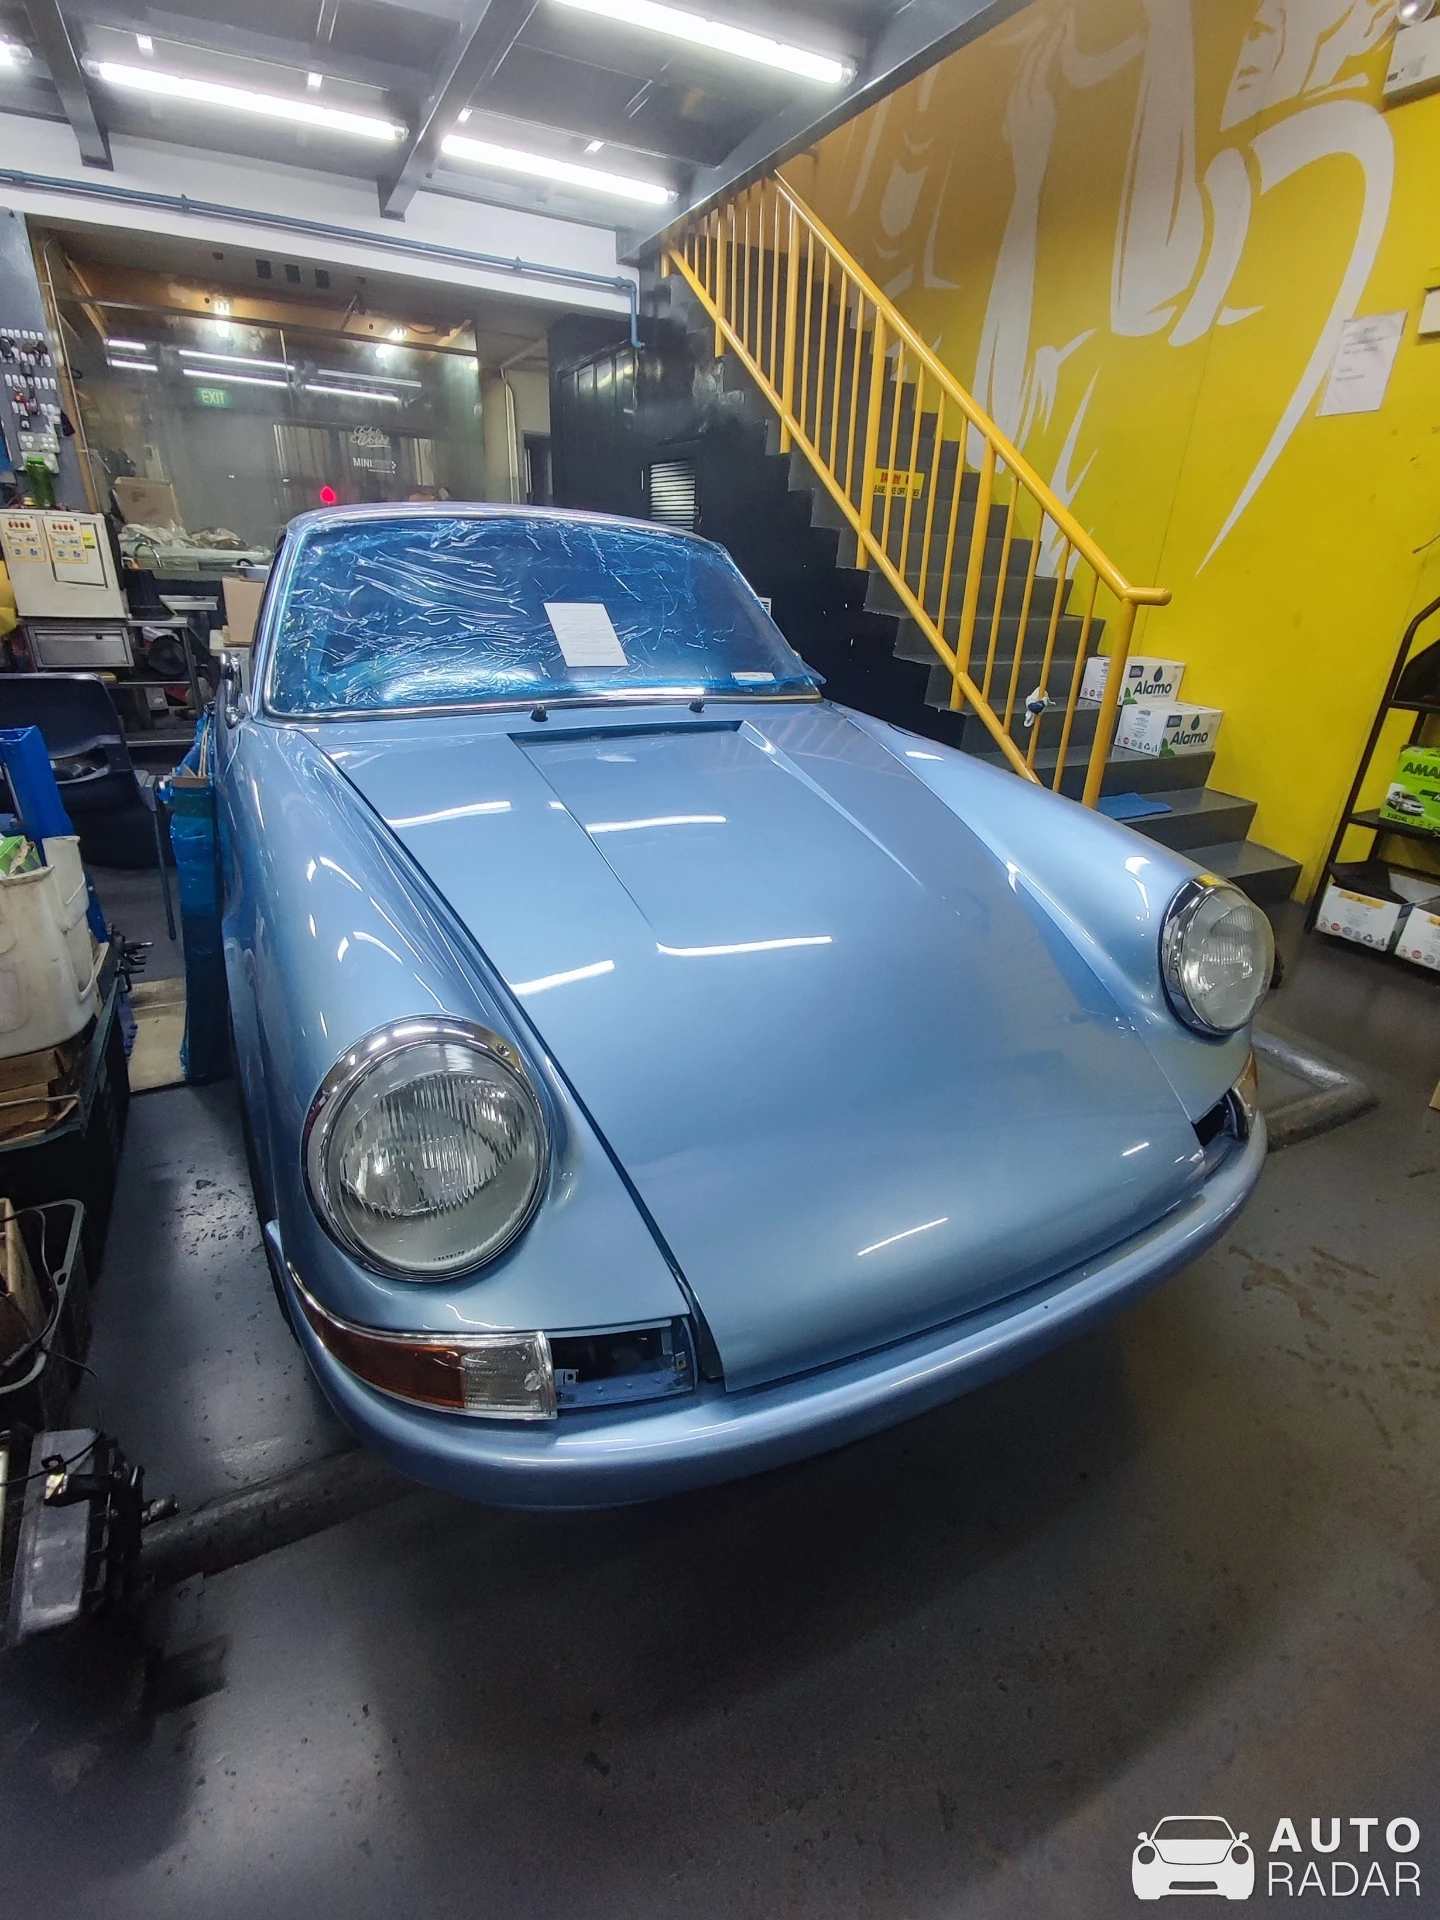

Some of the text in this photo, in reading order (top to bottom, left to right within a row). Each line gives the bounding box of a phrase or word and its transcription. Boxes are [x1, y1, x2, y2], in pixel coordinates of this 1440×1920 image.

[201, 389, 225, 405] EXIT
[1133, 680, 1172, 696] Alamo
[1170, 731, 1209, 746] Alamo
